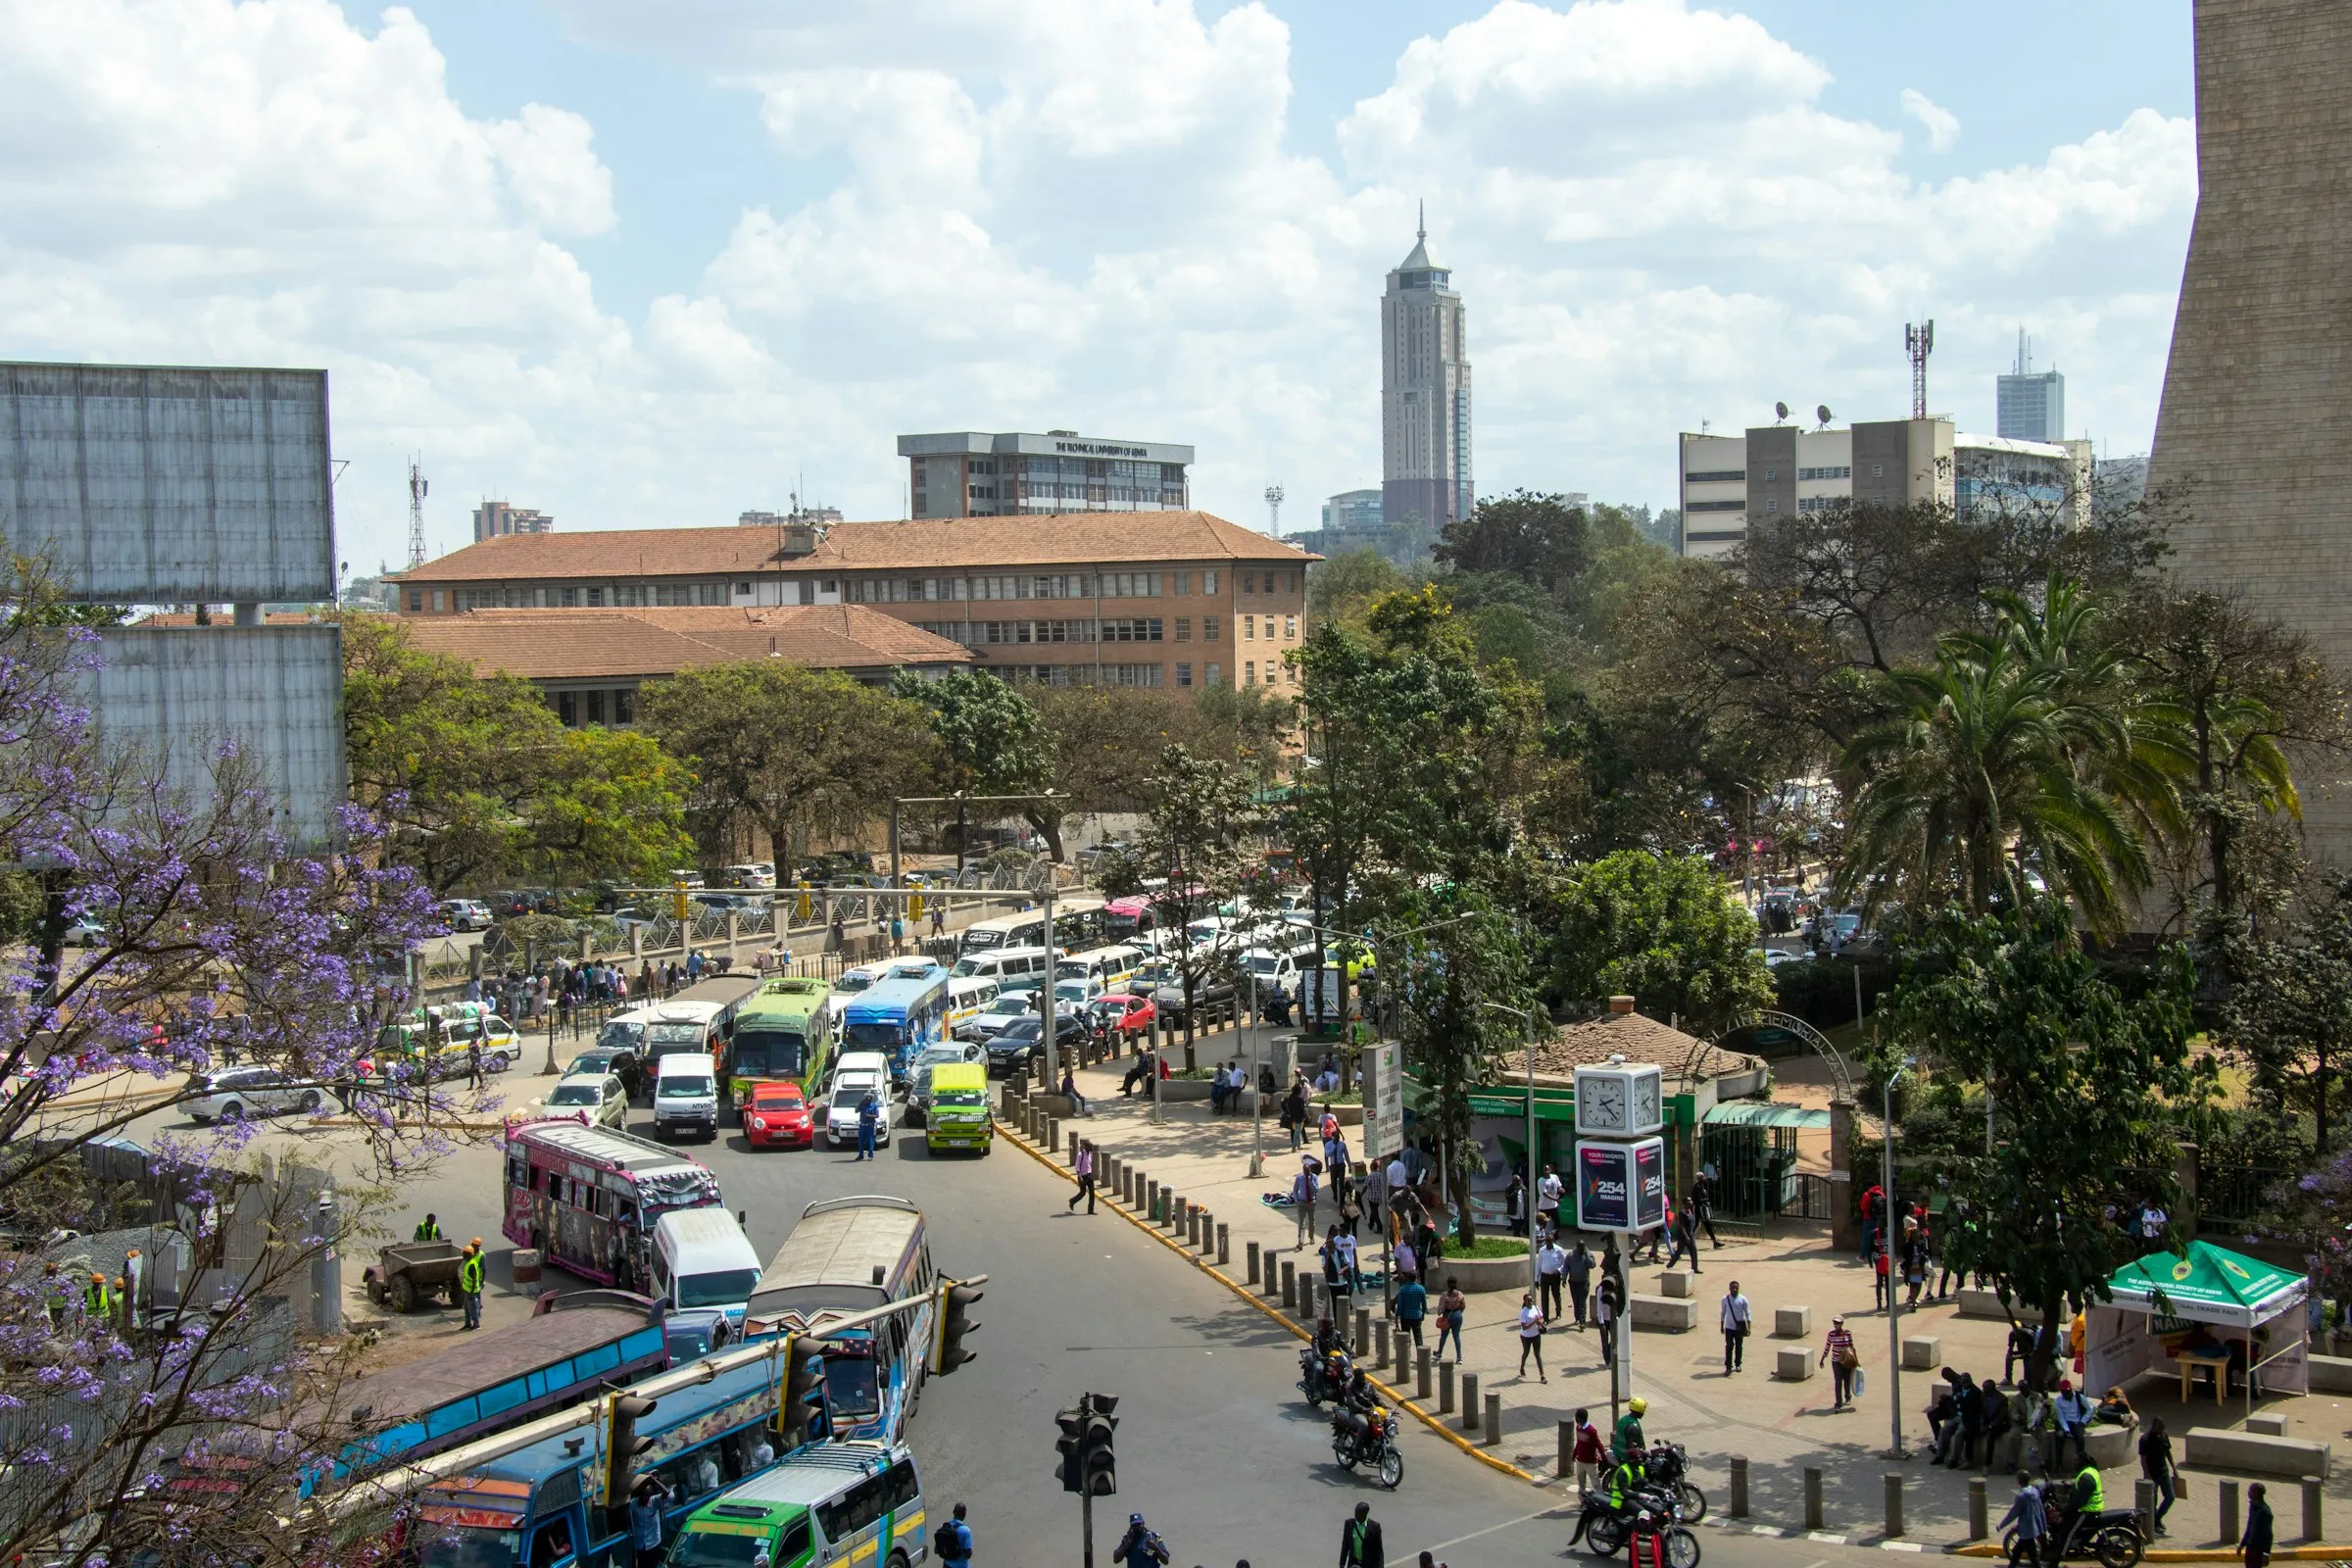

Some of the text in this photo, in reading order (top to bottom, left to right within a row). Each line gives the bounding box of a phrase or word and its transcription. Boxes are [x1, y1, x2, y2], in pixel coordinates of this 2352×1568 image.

[1055, 442, 1066, 453] THE
[1067, 443, 1094, 455] TECHNICAL
[1096, 444, 1123, 456] UNIVERSITY
[1124, 447, 1131, 456] OF
[1597, 1181, 1625, 1195] 254
[1645, 1175, 1660, 1191] 254
